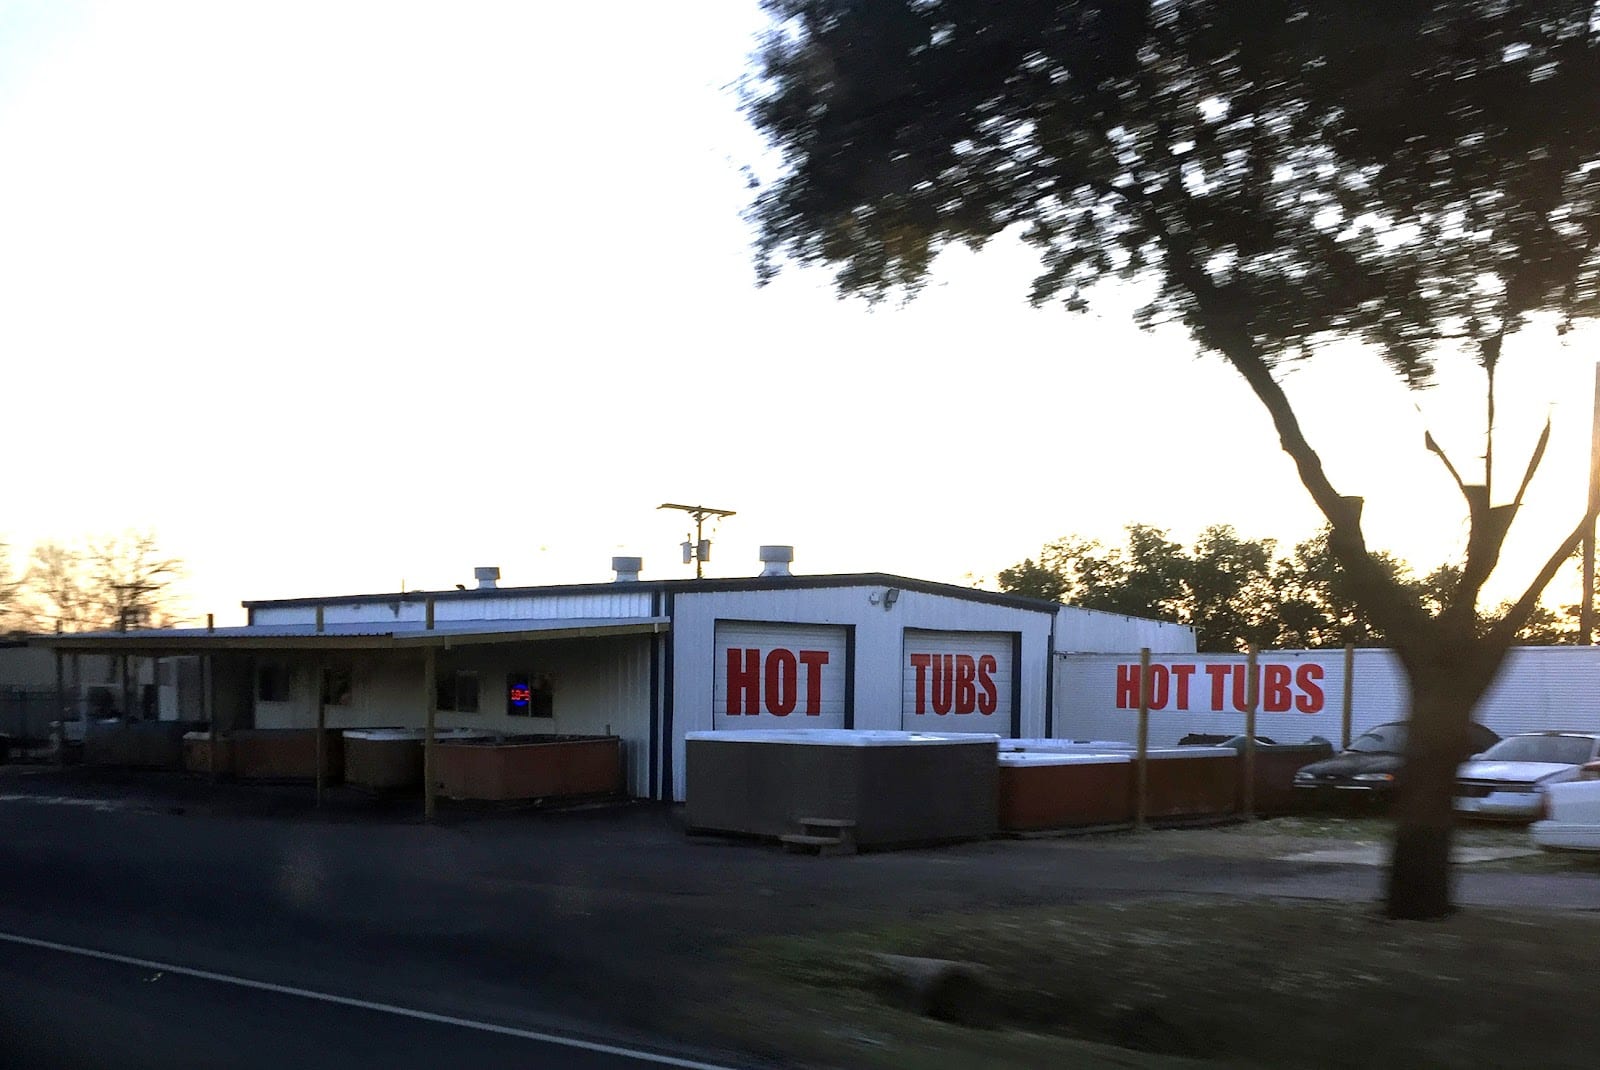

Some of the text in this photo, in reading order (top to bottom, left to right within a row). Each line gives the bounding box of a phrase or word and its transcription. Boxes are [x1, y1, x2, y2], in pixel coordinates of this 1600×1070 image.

[726, 648, 998, 716] HOT TUBS
[1116, 664, 1325, 713] HOT TUBS
